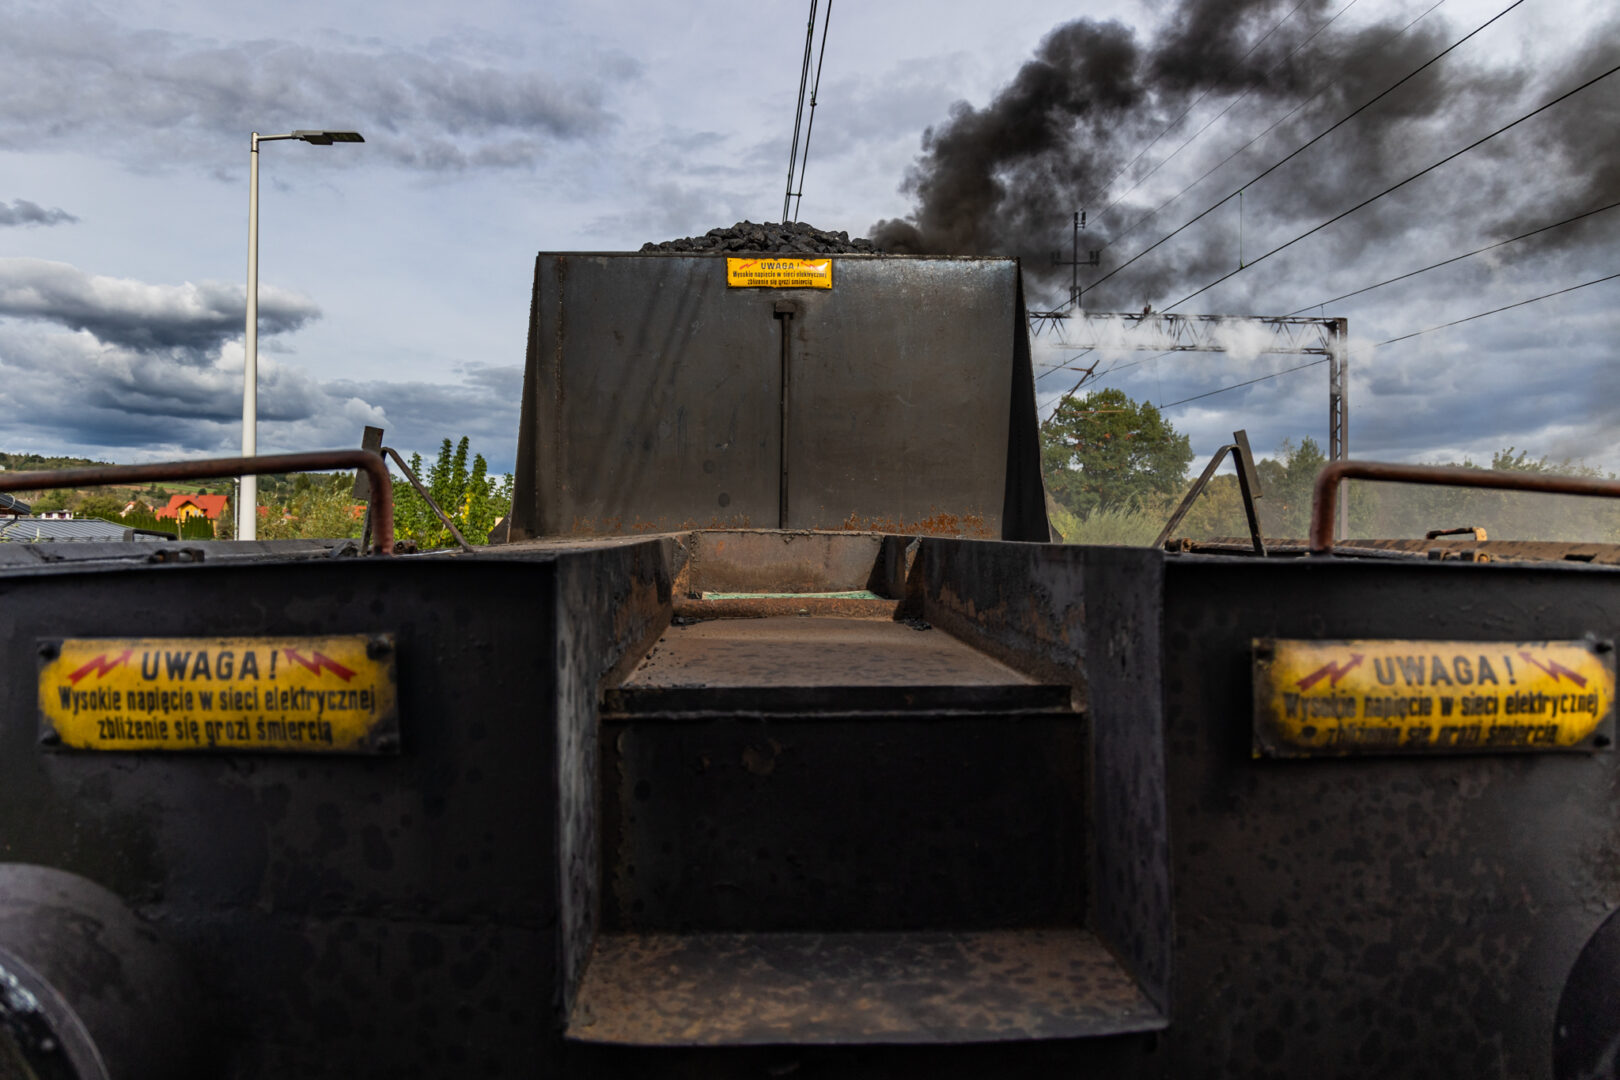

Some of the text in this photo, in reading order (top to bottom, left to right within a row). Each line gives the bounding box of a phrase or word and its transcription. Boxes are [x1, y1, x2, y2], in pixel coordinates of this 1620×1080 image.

[58, 685, 376, 715] Wysokie napięcie w sieci elektrycznej
[1364, 692, 1433, 721] napięcie
[1440, 696, 1454, 716] w
[1461, 691, 1498, 717] sieci
[1505, 690, 1599, 717] elektrycznej
[97, 719, 333, 745] zbliżenie się grozi śmiercią
